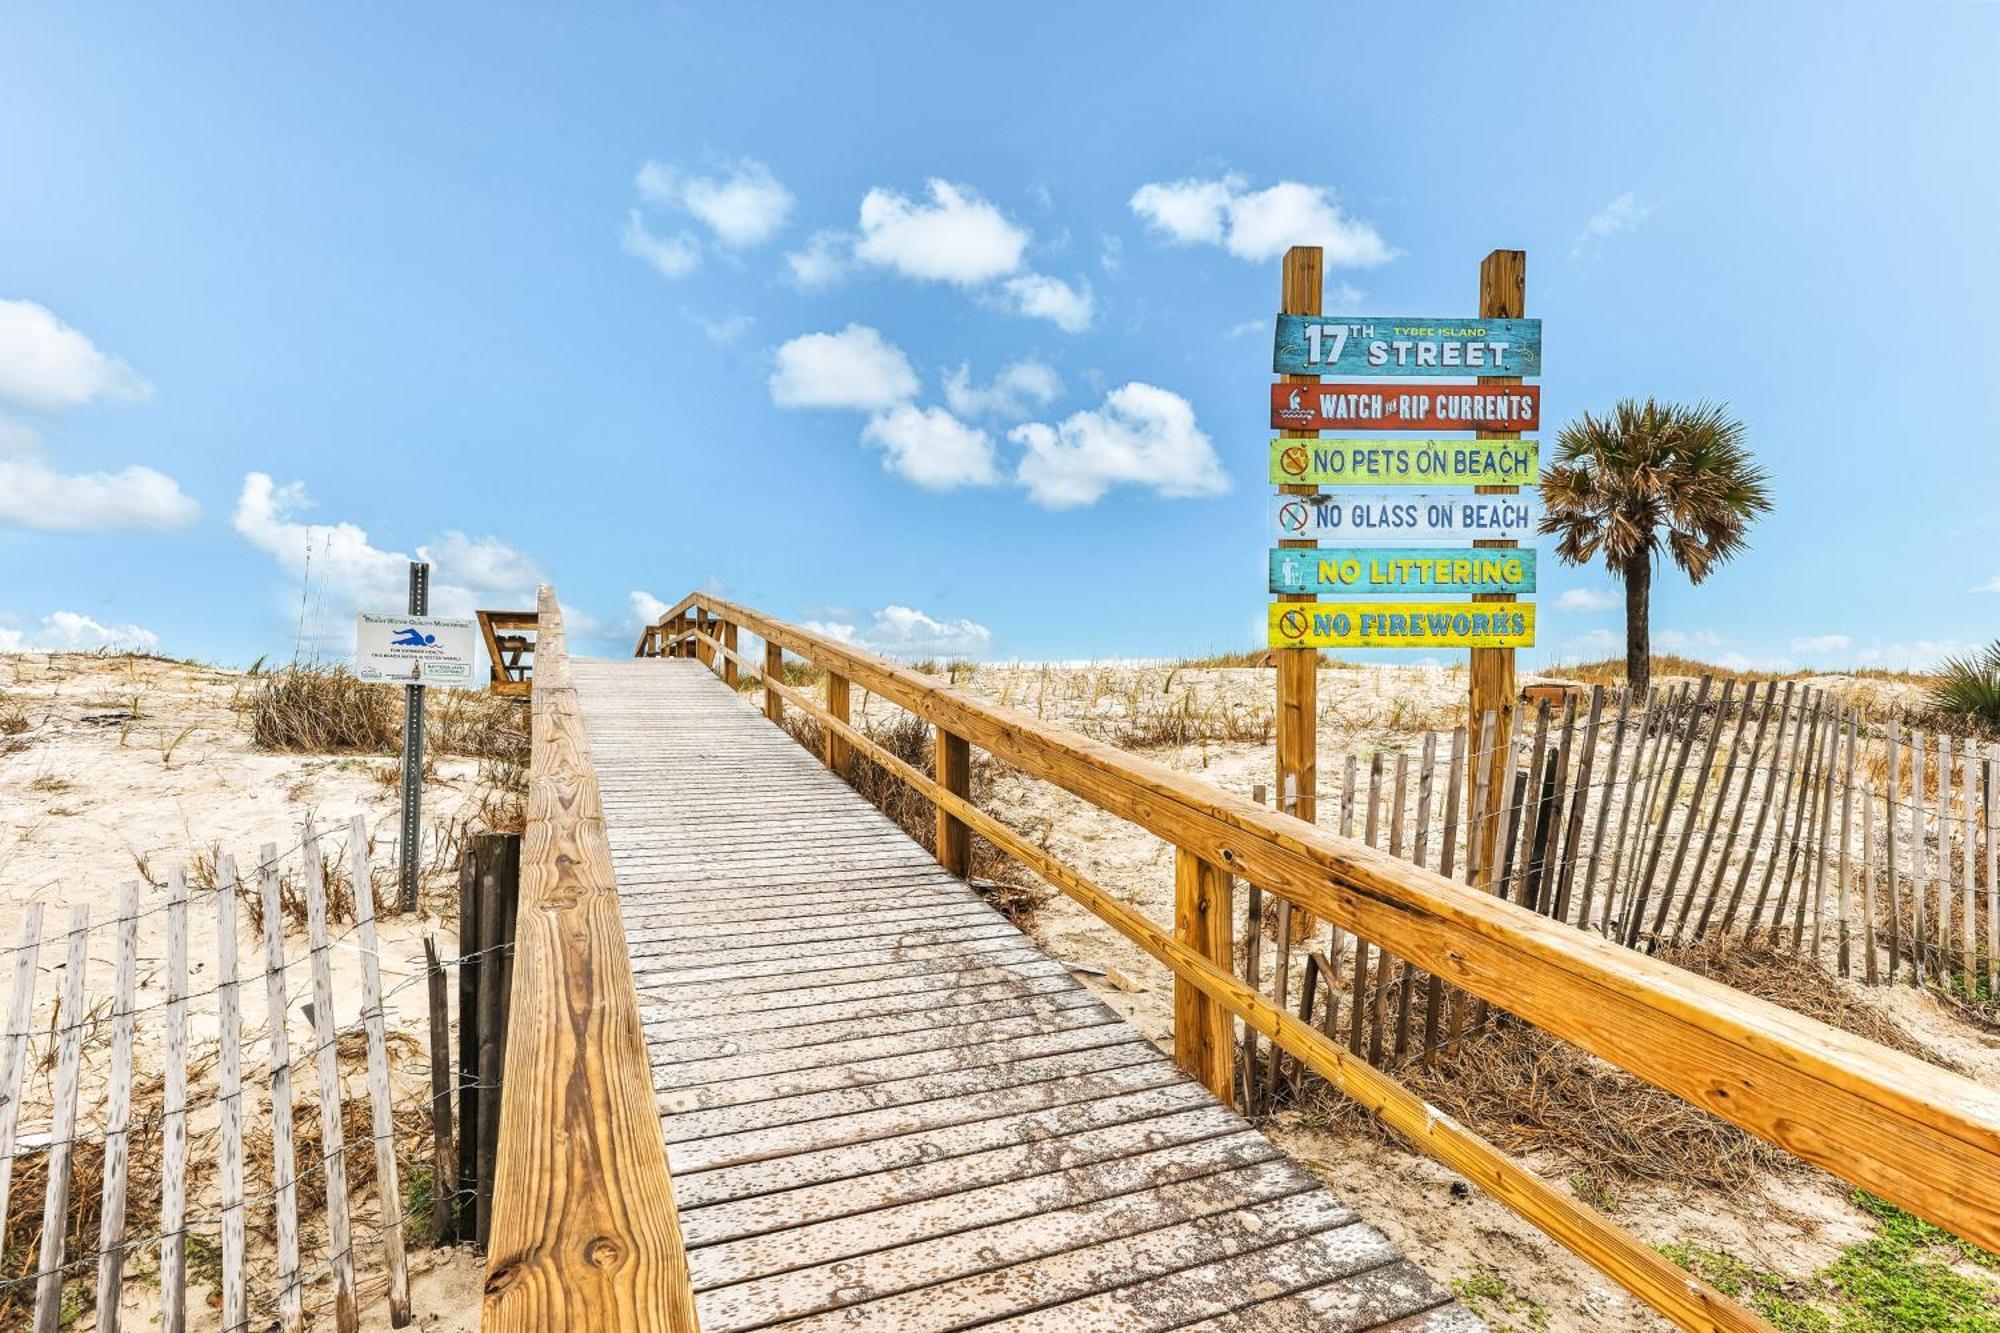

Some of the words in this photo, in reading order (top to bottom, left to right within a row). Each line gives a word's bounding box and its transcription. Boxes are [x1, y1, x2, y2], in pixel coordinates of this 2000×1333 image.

[1394, 328, 1435, 336] TYBEE
[1440, 328, 1487, 337] ISLAND
[1368, 340, 1509, 367] STREET
[1319, 393, 1382, 419] WATCH
[1400, 394, 1429, 420] RIP
[1436, 395, 1532, 420] CURRENTS
[1314, 449, 1344, 473] NO
[1352, 449, 1409, 474] PETS
[1416, 449, 1446, 474] ON
[1454, 450, 1528, 474] BEACH
[1316, 504, 1342, 528] NO
[1351, 504, 1418, 528] GLASS
[1427, 504, 1453, 528] ON
[1462, 505, 1529, 528] BEACH
[1317, 559, 1361, 585] NO
[1369, 559, 1524, 585] LITTERING
[1313, 613, 1351, 637] NO
[1359, 613, 1525, 637] FIREWORKS
